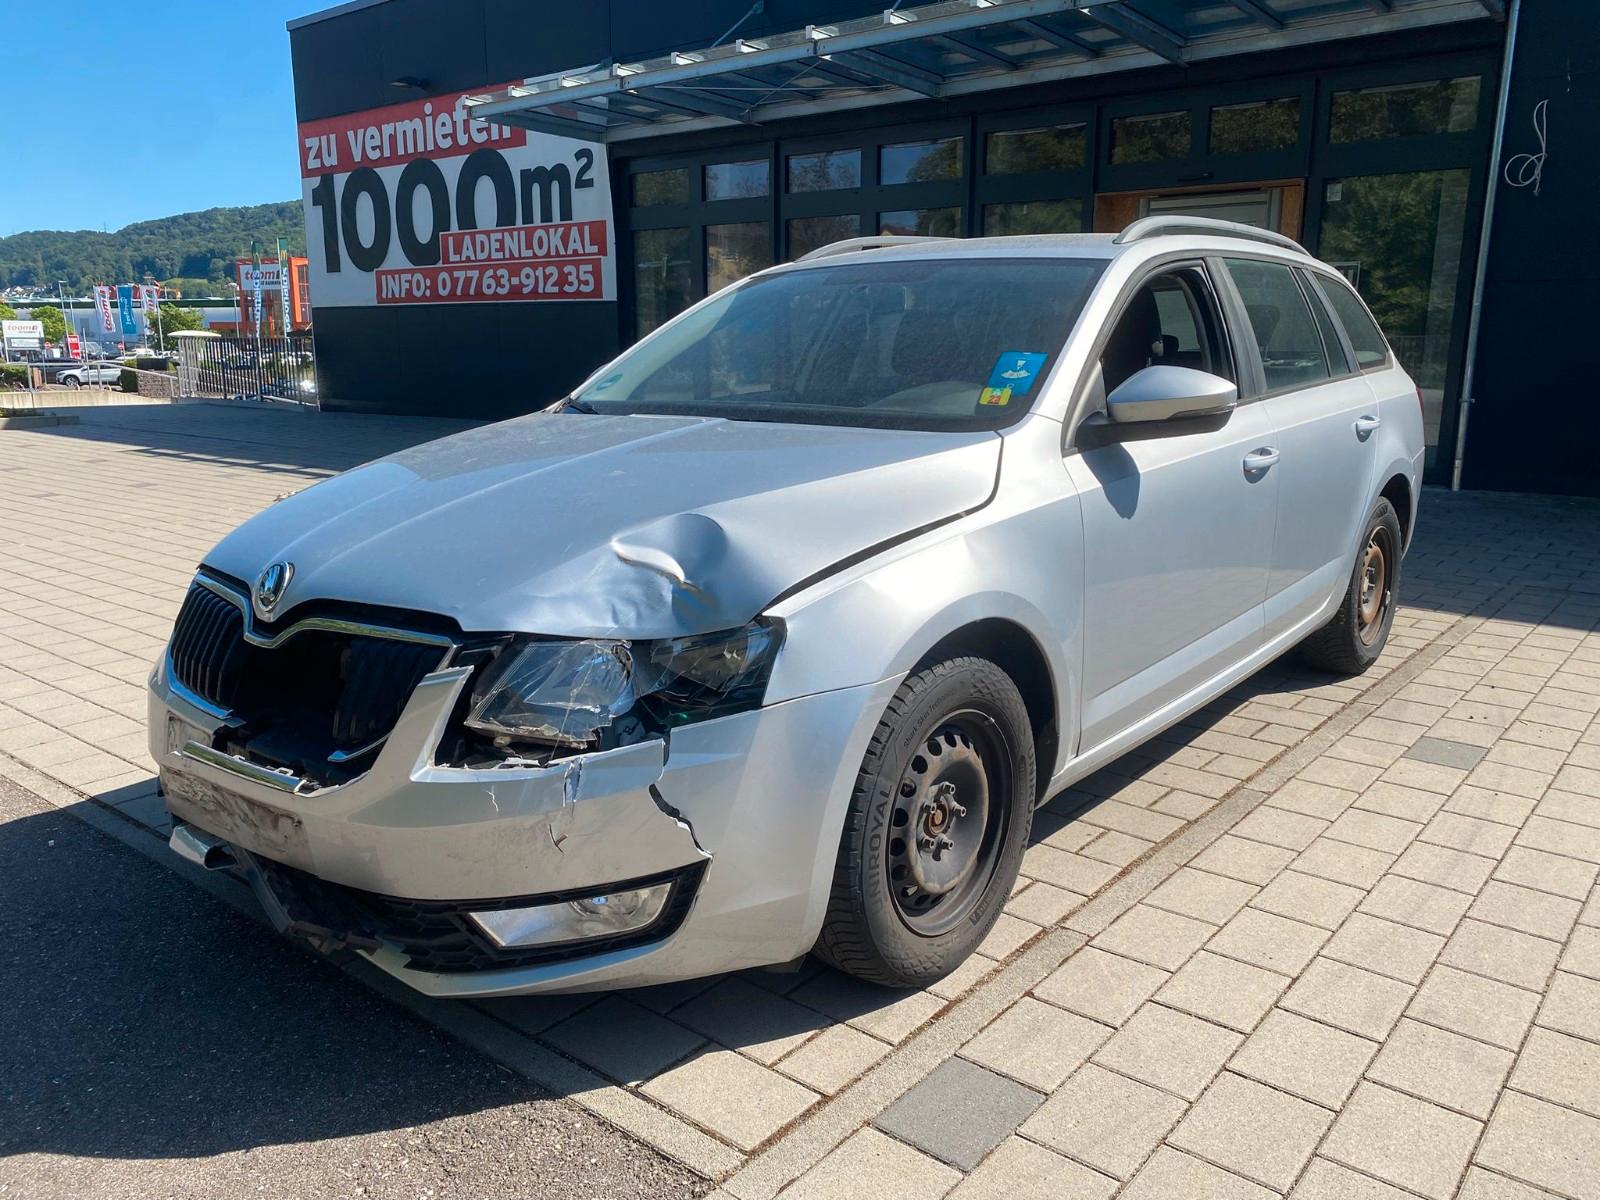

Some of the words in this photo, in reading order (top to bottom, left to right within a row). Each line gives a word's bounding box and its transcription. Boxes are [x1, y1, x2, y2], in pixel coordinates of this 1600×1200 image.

[304, 133, 338, 170] zu
[448, 225, 598, 262] LADENLOKAL
[381, 270, 431, 299] INFO:
[868, 784, 893, 914] UNIROYAL
